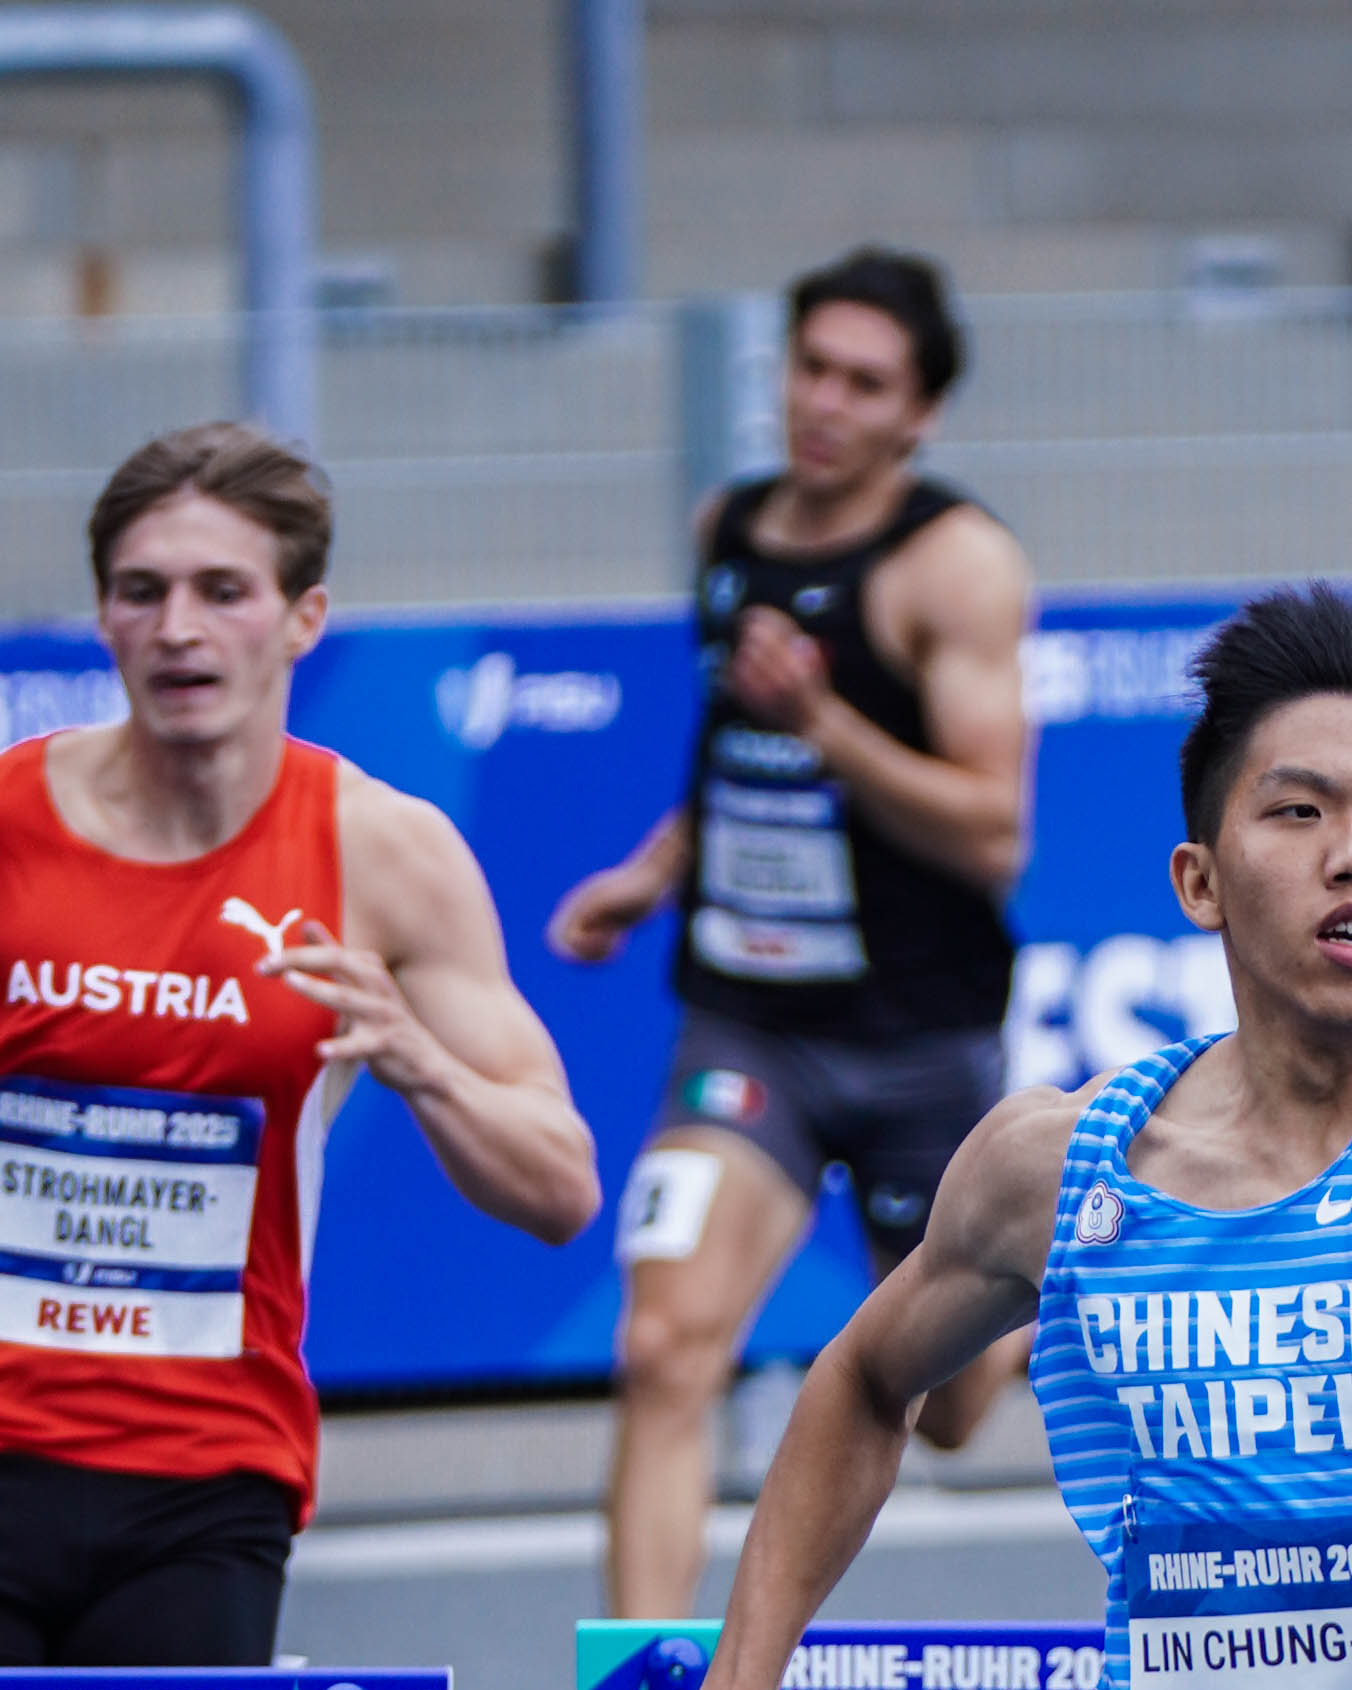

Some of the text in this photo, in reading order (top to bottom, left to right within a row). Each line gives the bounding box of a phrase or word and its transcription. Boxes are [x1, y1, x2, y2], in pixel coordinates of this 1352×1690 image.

[7, 959, 249, 1024] AUSTRIA
[1003, 932, 1239, 1098] EST
[2, 1160, 218, 1213] STROHMAYER-
[55, 1209, 154, 1250] DANGL
[37, 1298, 152, 1337] REWE
[1149, 1545, 1324, 1591] RHINE-RUHR
[1142, 1631, 1193, 1673] LIN
